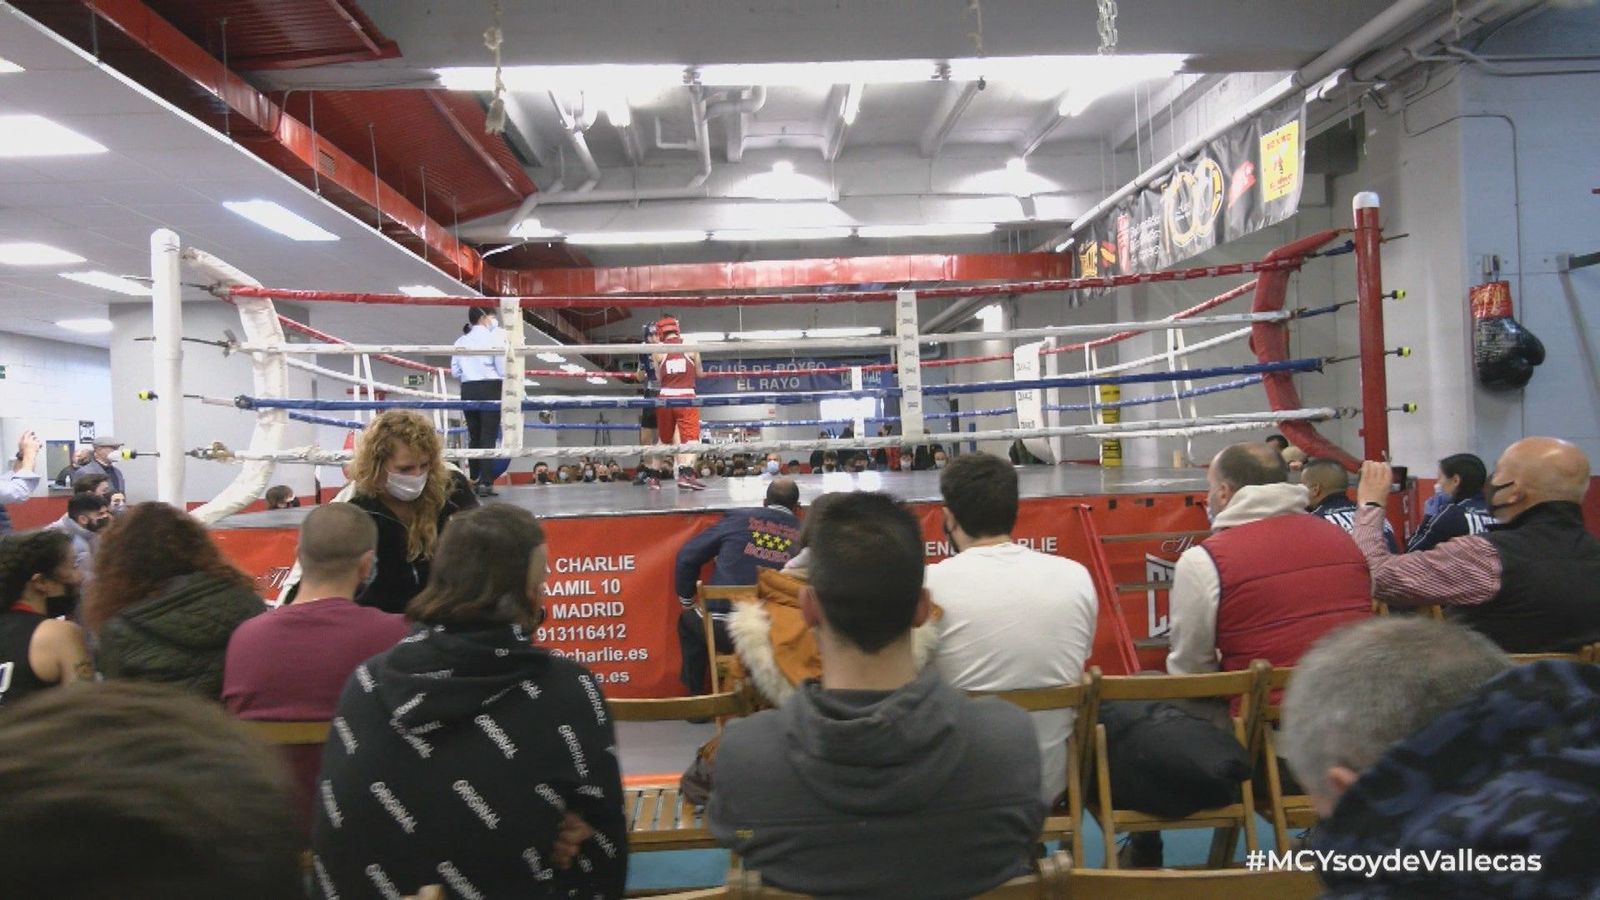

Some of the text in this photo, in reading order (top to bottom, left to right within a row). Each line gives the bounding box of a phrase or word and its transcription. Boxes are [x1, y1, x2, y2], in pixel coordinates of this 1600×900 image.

[737, 377, 800, 391] EL RAYO
[555, 555, 636, 573] CHARLIE
[601, 578, 621, 594] 10
[552, 601, 625, 619] MADRID
[536, 623, 627, 641] 913116412
